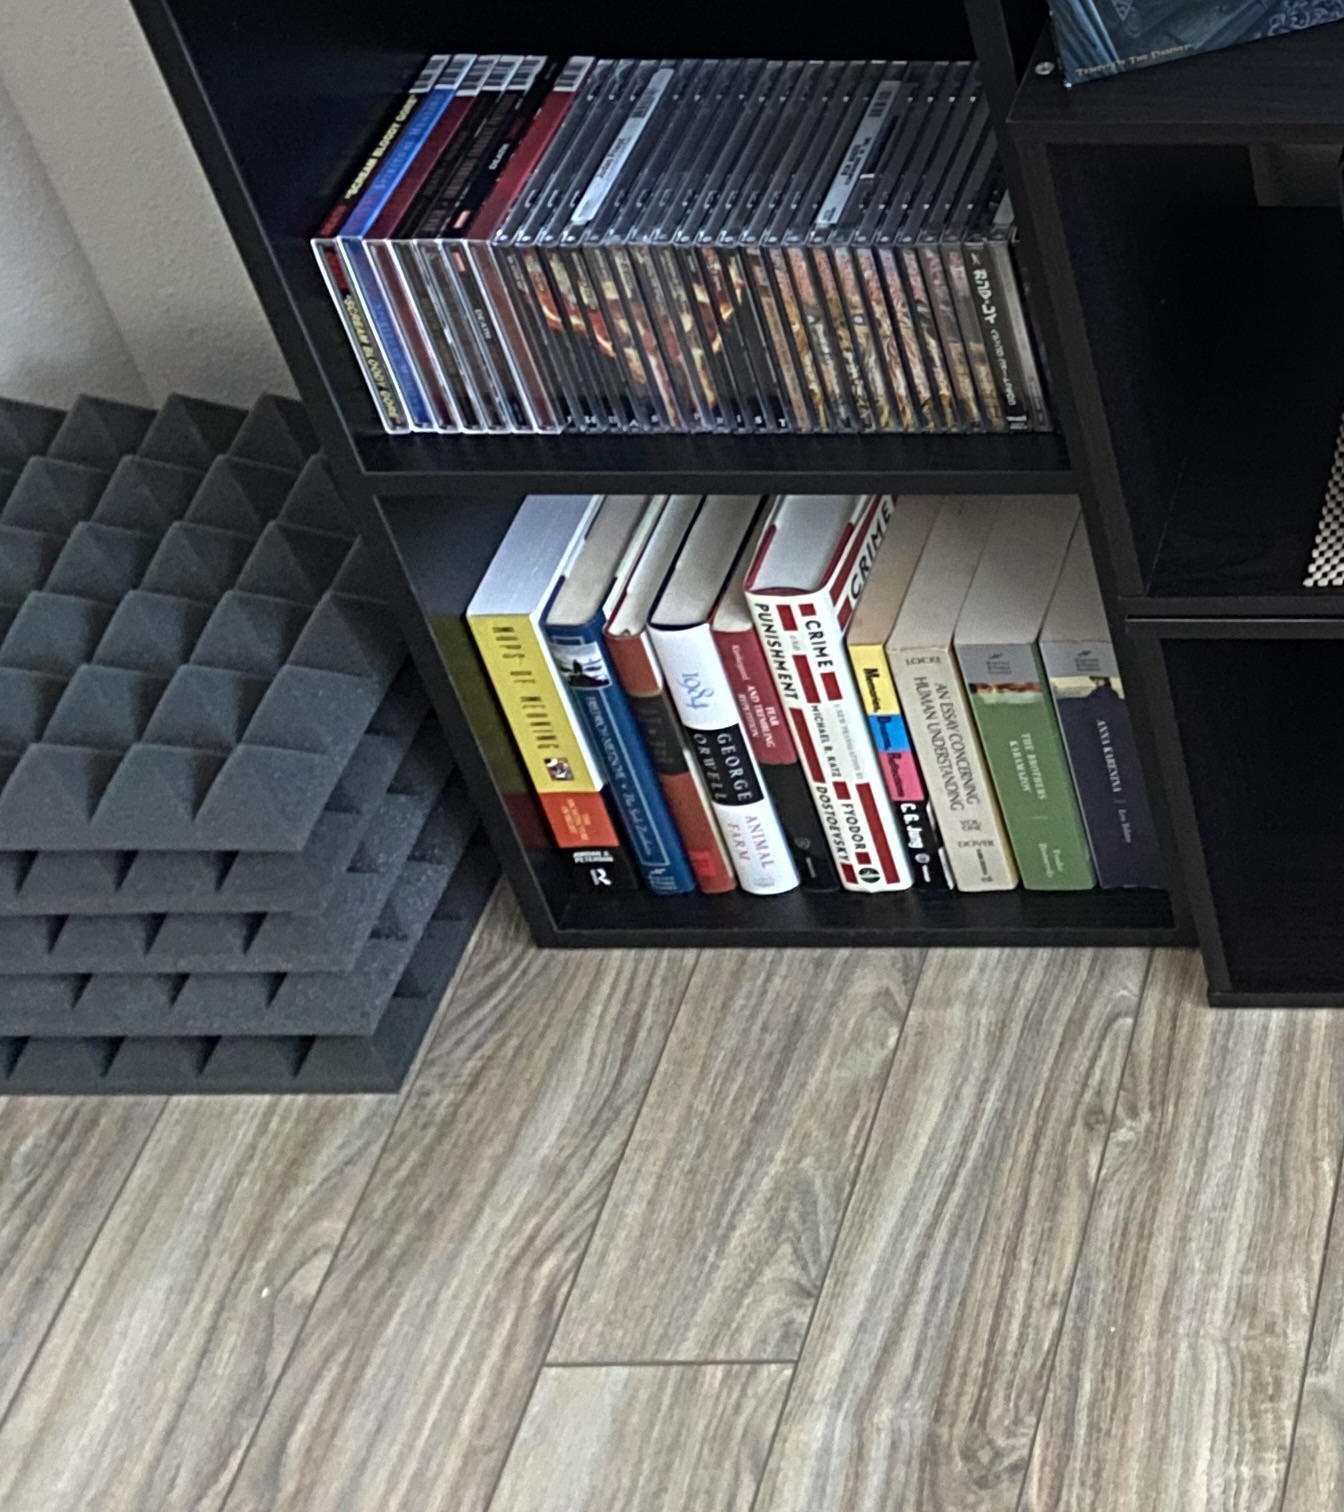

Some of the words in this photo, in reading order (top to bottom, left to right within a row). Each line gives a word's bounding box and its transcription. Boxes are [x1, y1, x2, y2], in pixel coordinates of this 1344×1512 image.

[850, 494, 893, 601] CRIME
[755, 602, 800, 701] PUNISHMENT
[805, 619, 834, 668] CRIME
[681, 672, 715, 711] 1984
[934, 681, 948, 700] AN
[939, 700, 956, 732] ESSAY
[693, 733, 728, 801] ORWELL
[717, 733, 753, 801] GEORGE
[810, 705, 828, 742] MICHAEL
[828, 755, 842, 778] KATZ
[914, 675, 934, 720] HUMAN
[926, 721, 965, 812] UNDERSTANDING
[949, 731, 981, 805] CONCERNING
[727, 822, 752, 862] FARM
[744, 815, 776, 869] ANIMAL
[816, 786, 851, 861] DOSTOEVSKY
[841, 802, 867, 850] FYODOR
